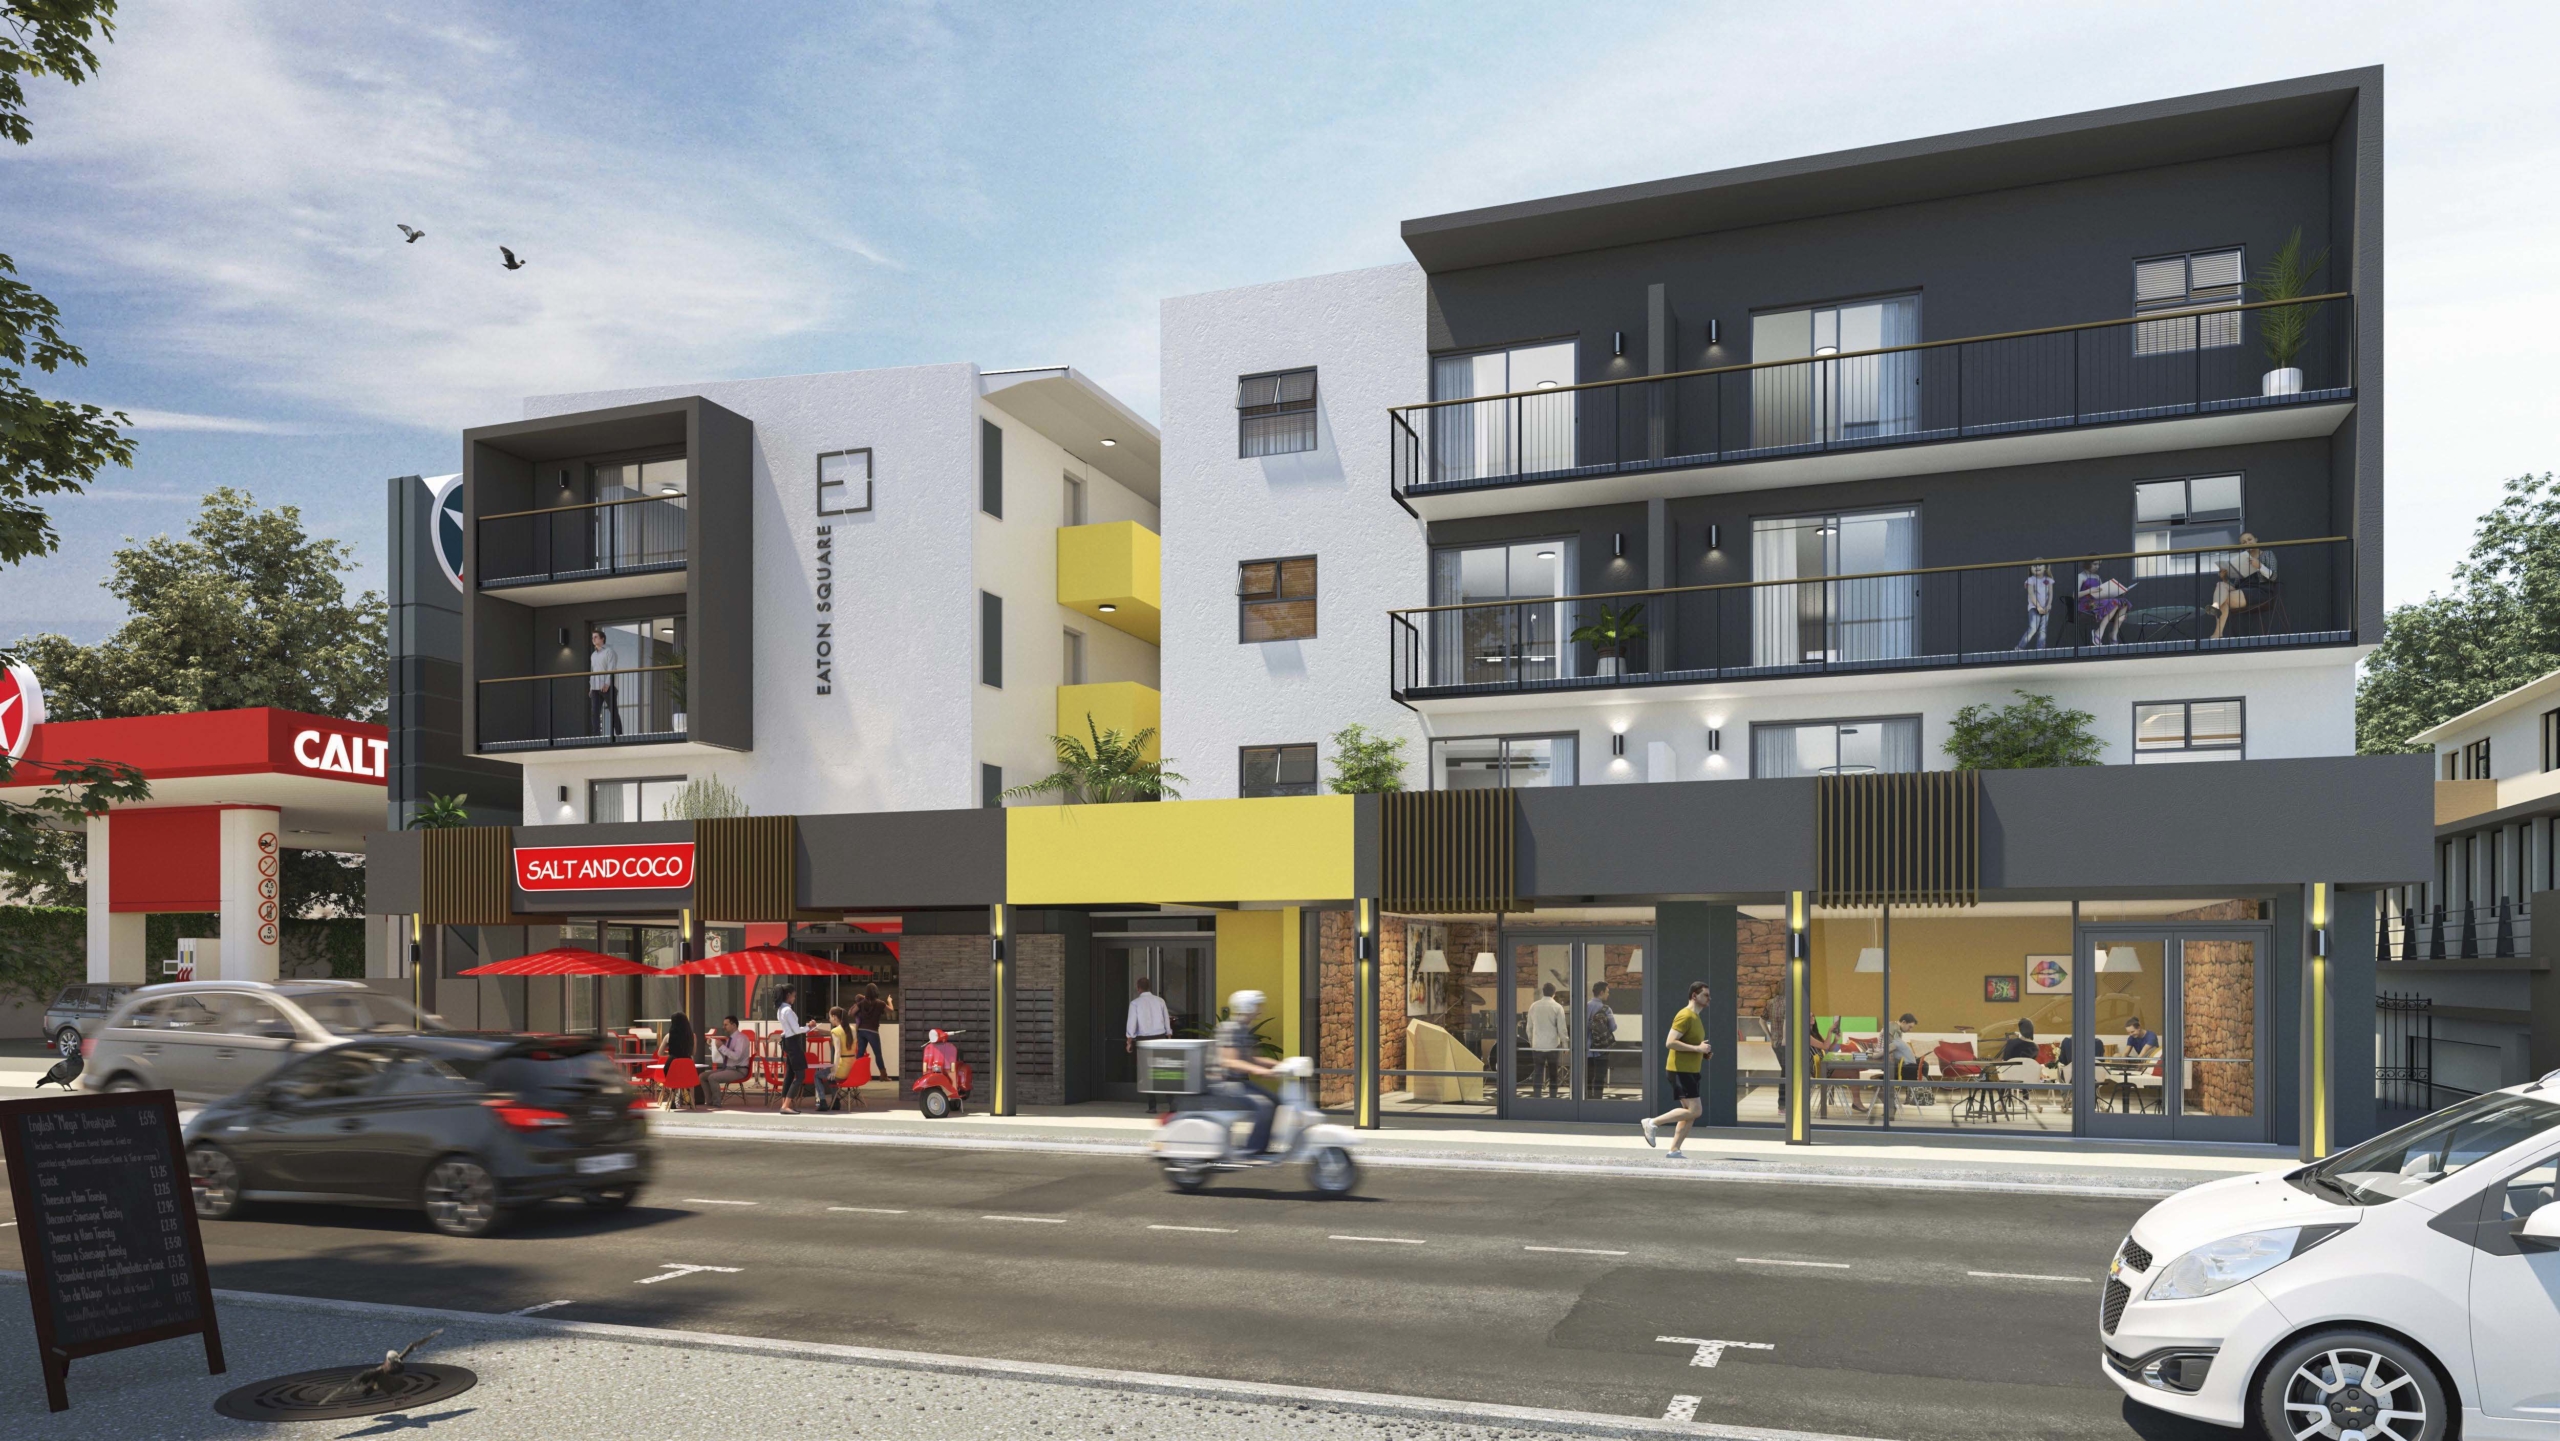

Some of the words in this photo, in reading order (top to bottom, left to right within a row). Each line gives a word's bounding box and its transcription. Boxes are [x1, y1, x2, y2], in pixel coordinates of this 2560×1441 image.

[817, 525, 831, 613] SQUARE
[817, 623, 831, 695] EATON
[526, 860, 578, 880] SALT
[578, 859, 620, 879] AND
[622, 856, 683, 878] COCO
[27, 1114, 55, 1136] English
[81, 1112, 117, 1132] Breakfast
[37, 1173, 60, 1188] Toast
[41, 1193, 65, 1206] Cheese
[65, 1195, 72, 1204] or
[71, 1190, 86, 1203] Ham
[44, 1211, 66, 1225] Bacon
[65, 1214, 73, 1223] or
[73, 1209, 101, 1224] Sausage
[48, 1231, 72, 1245] Cheese
[79, 1228, 94, 1241] Ham
[51, 1250, 73, 1264] Bacon
[78, 1247, 106, 1262] Sausage
[86, 1270, 92, 1279] or
